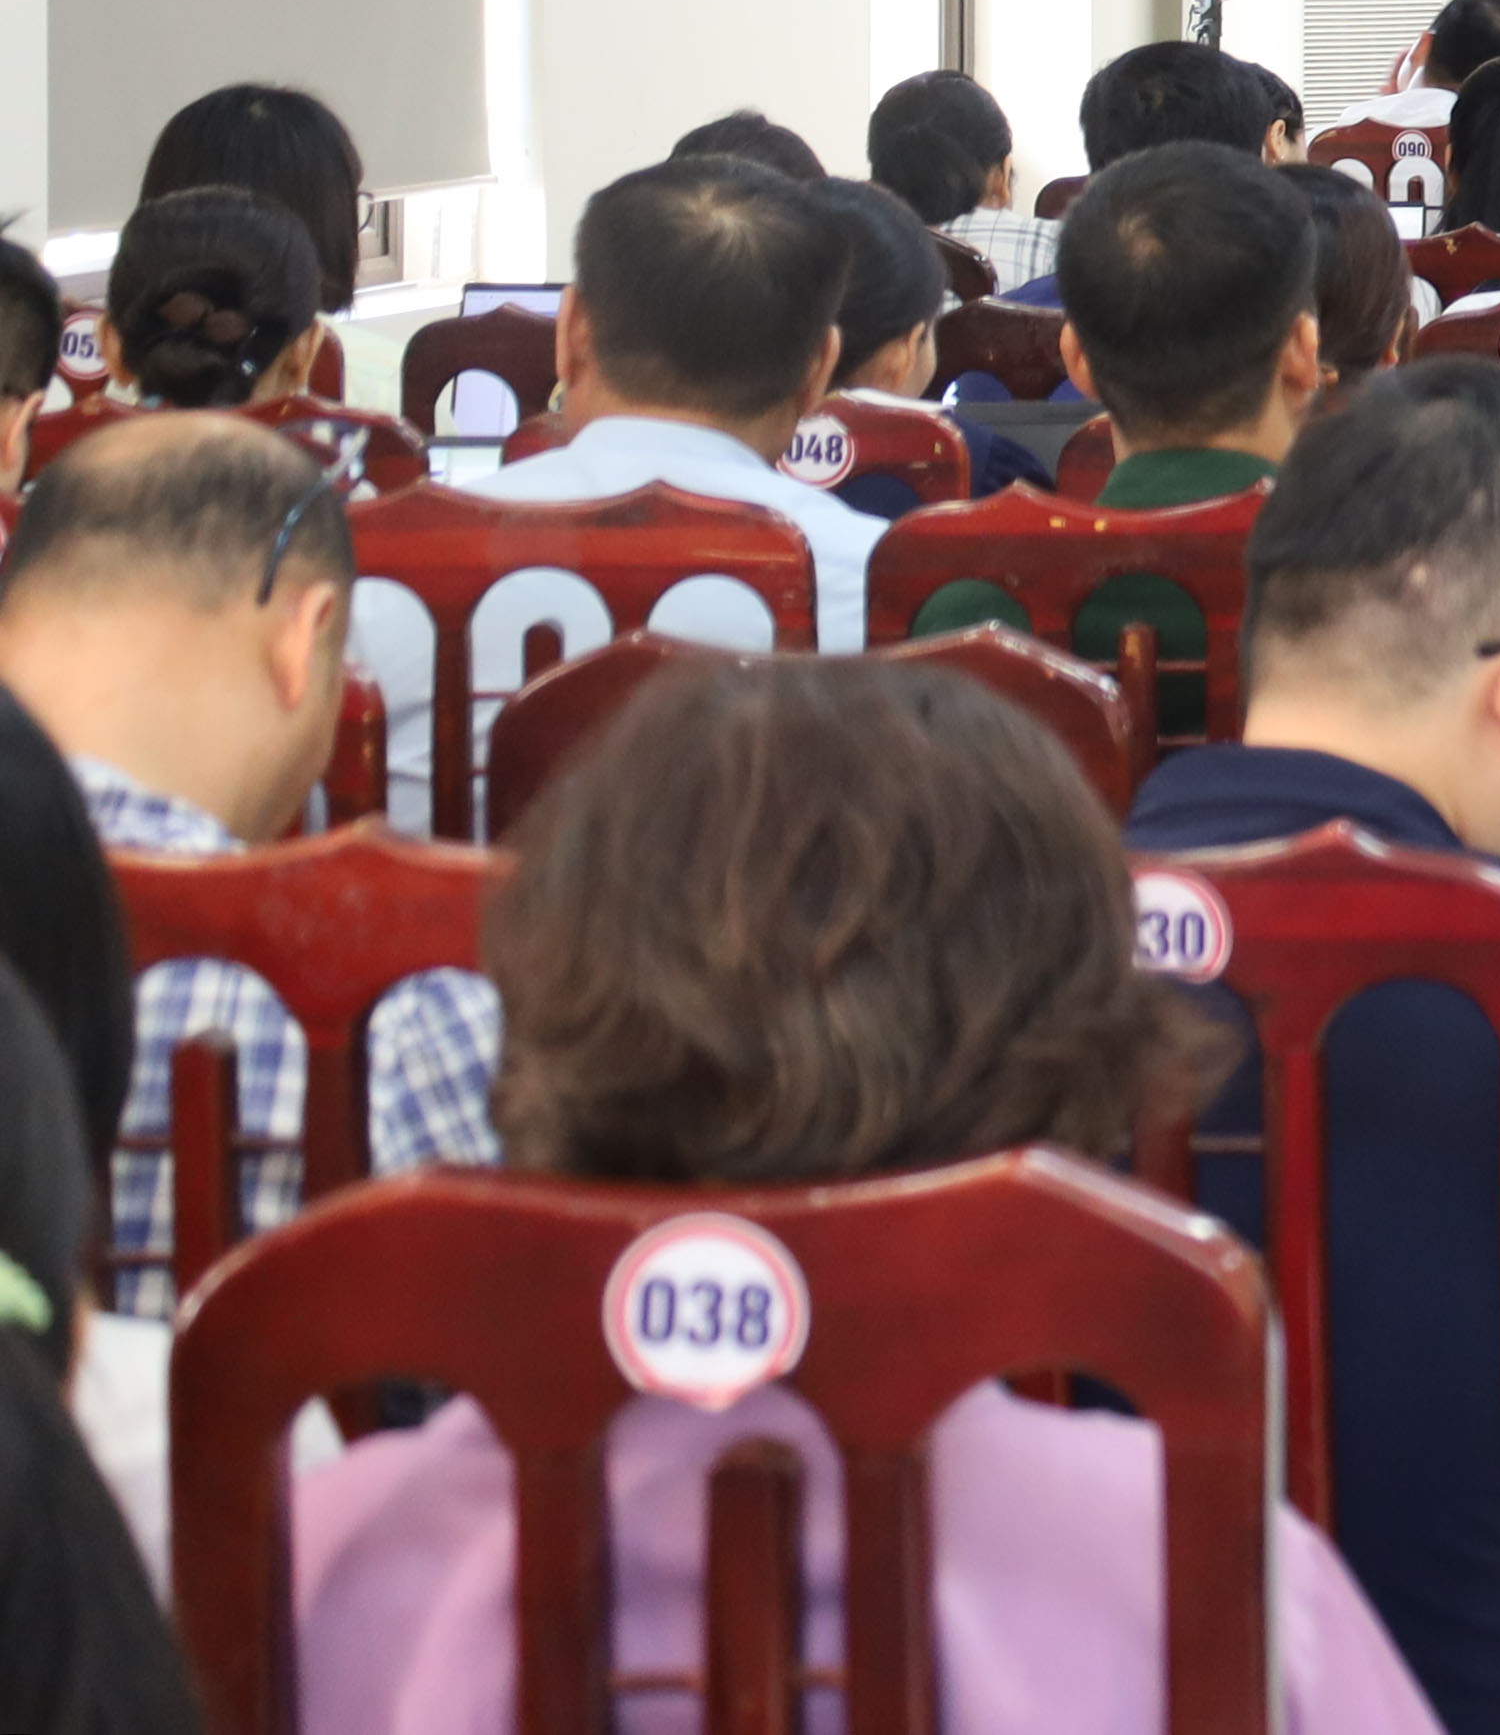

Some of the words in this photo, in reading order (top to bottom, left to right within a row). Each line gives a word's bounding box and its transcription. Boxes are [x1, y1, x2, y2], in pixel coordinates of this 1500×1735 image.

[1397, 141, 1426, 157] 090
[61, 332, 99, 358] 05
[786, 434, 844, 465] 048
[1137, 911, 1206, 960] 30
[638, 1278, 771, 1347] 038
